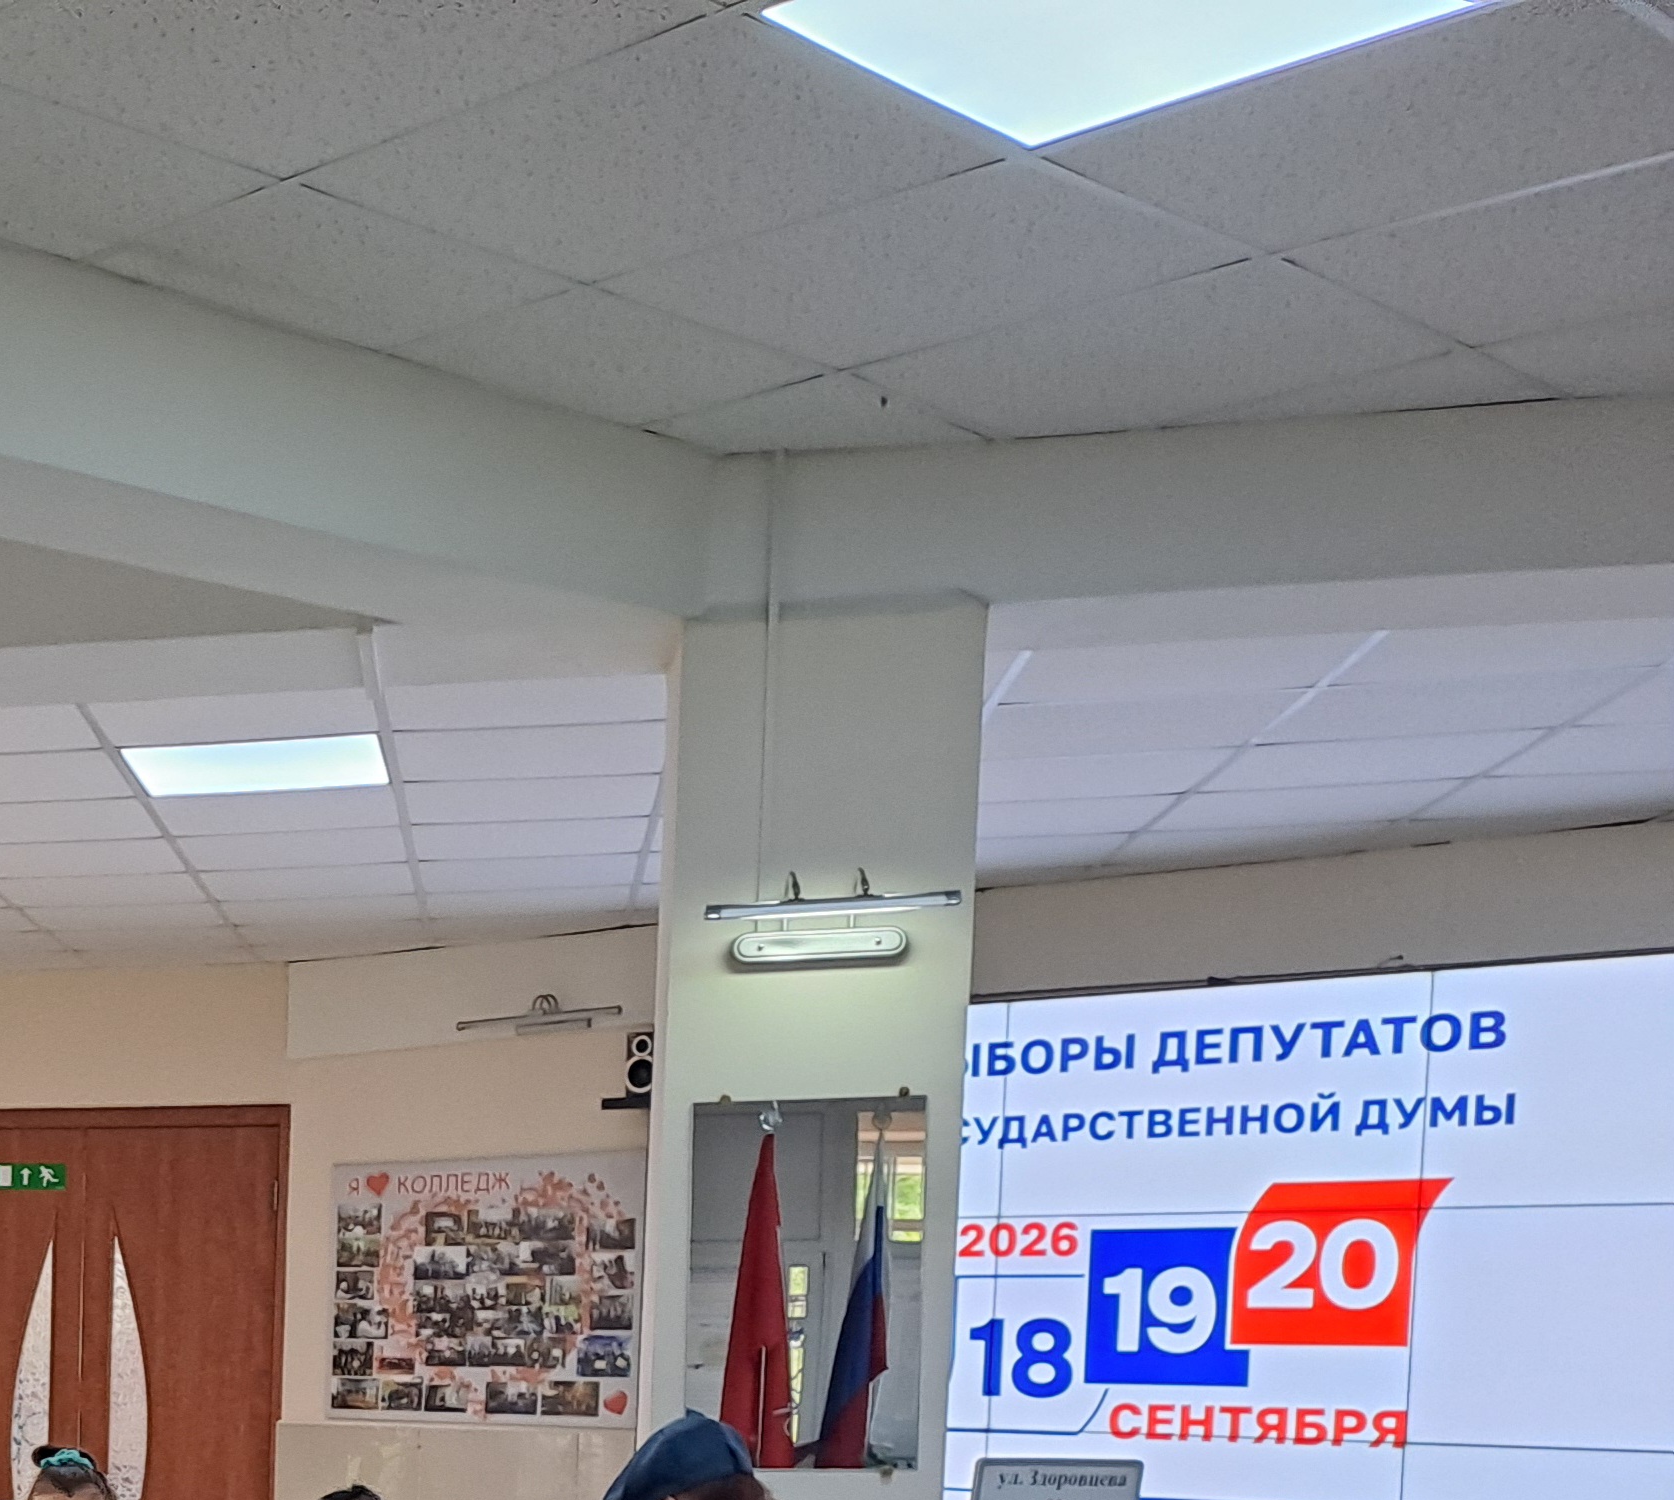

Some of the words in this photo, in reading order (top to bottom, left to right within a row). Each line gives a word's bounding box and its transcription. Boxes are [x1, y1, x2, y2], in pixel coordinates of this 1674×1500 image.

[1152, 1011, 1507, 1074] ДЕПУТАТОВ
[1355, 1094, 1516, 1136] ДУМЫ
[348, 1177, 360, 1196] Я
[397, 1172, 510, 1194] КОЛЛЕДЖ
[958, 1222, 1078, 1258] 2026
[1246, 1218, 1400, 1310] 20
[1103, 1267, 1217, 1354] 19
[970, 1318, 1073, 1398] 18
[1110, 1403, 1407, 1448] СЕНТЯБРЯ
